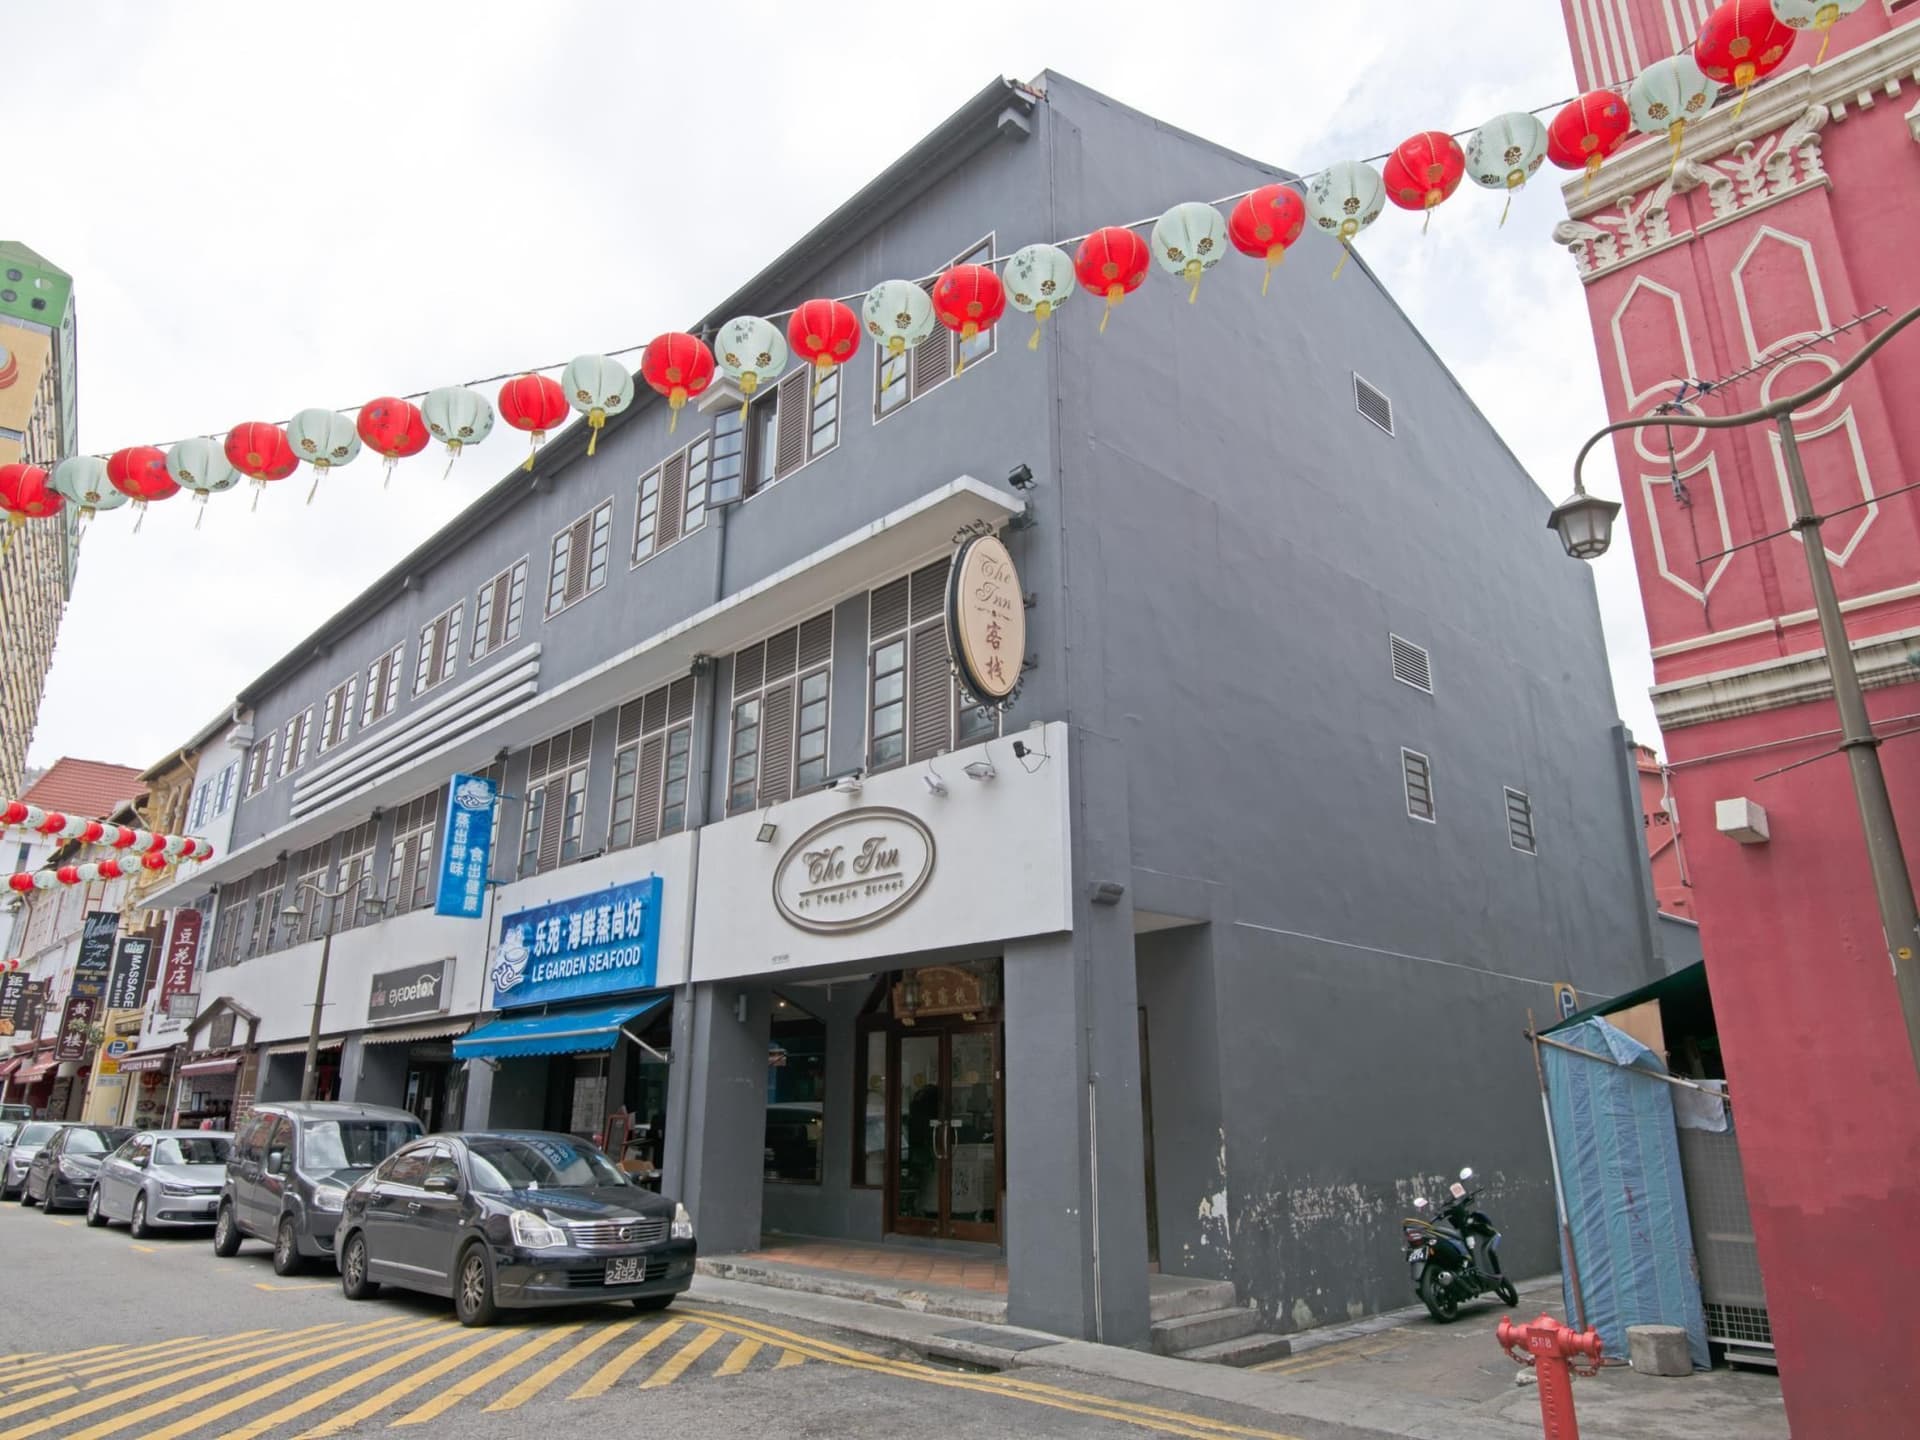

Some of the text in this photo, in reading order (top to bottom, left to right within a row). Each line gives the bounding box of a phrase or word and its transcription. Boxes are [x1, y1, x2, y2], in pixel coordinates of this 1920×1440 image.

[980, 552, 1012, 585] The
[975, 581, 1011, 610] Inn
[985, 621, 1007, 685] 客栈
[802, 836, 900, 885] The Inn
[798, 879, 904, 910] at Temple Street
[166, 928, 195, 986] 豆花庄
[531, 945, 641, 983] LE GARDEN SEAFOOD
[122, 954, 143, 1009] MASSAGE
[63, 1001, 91, 1048] 黄楼
